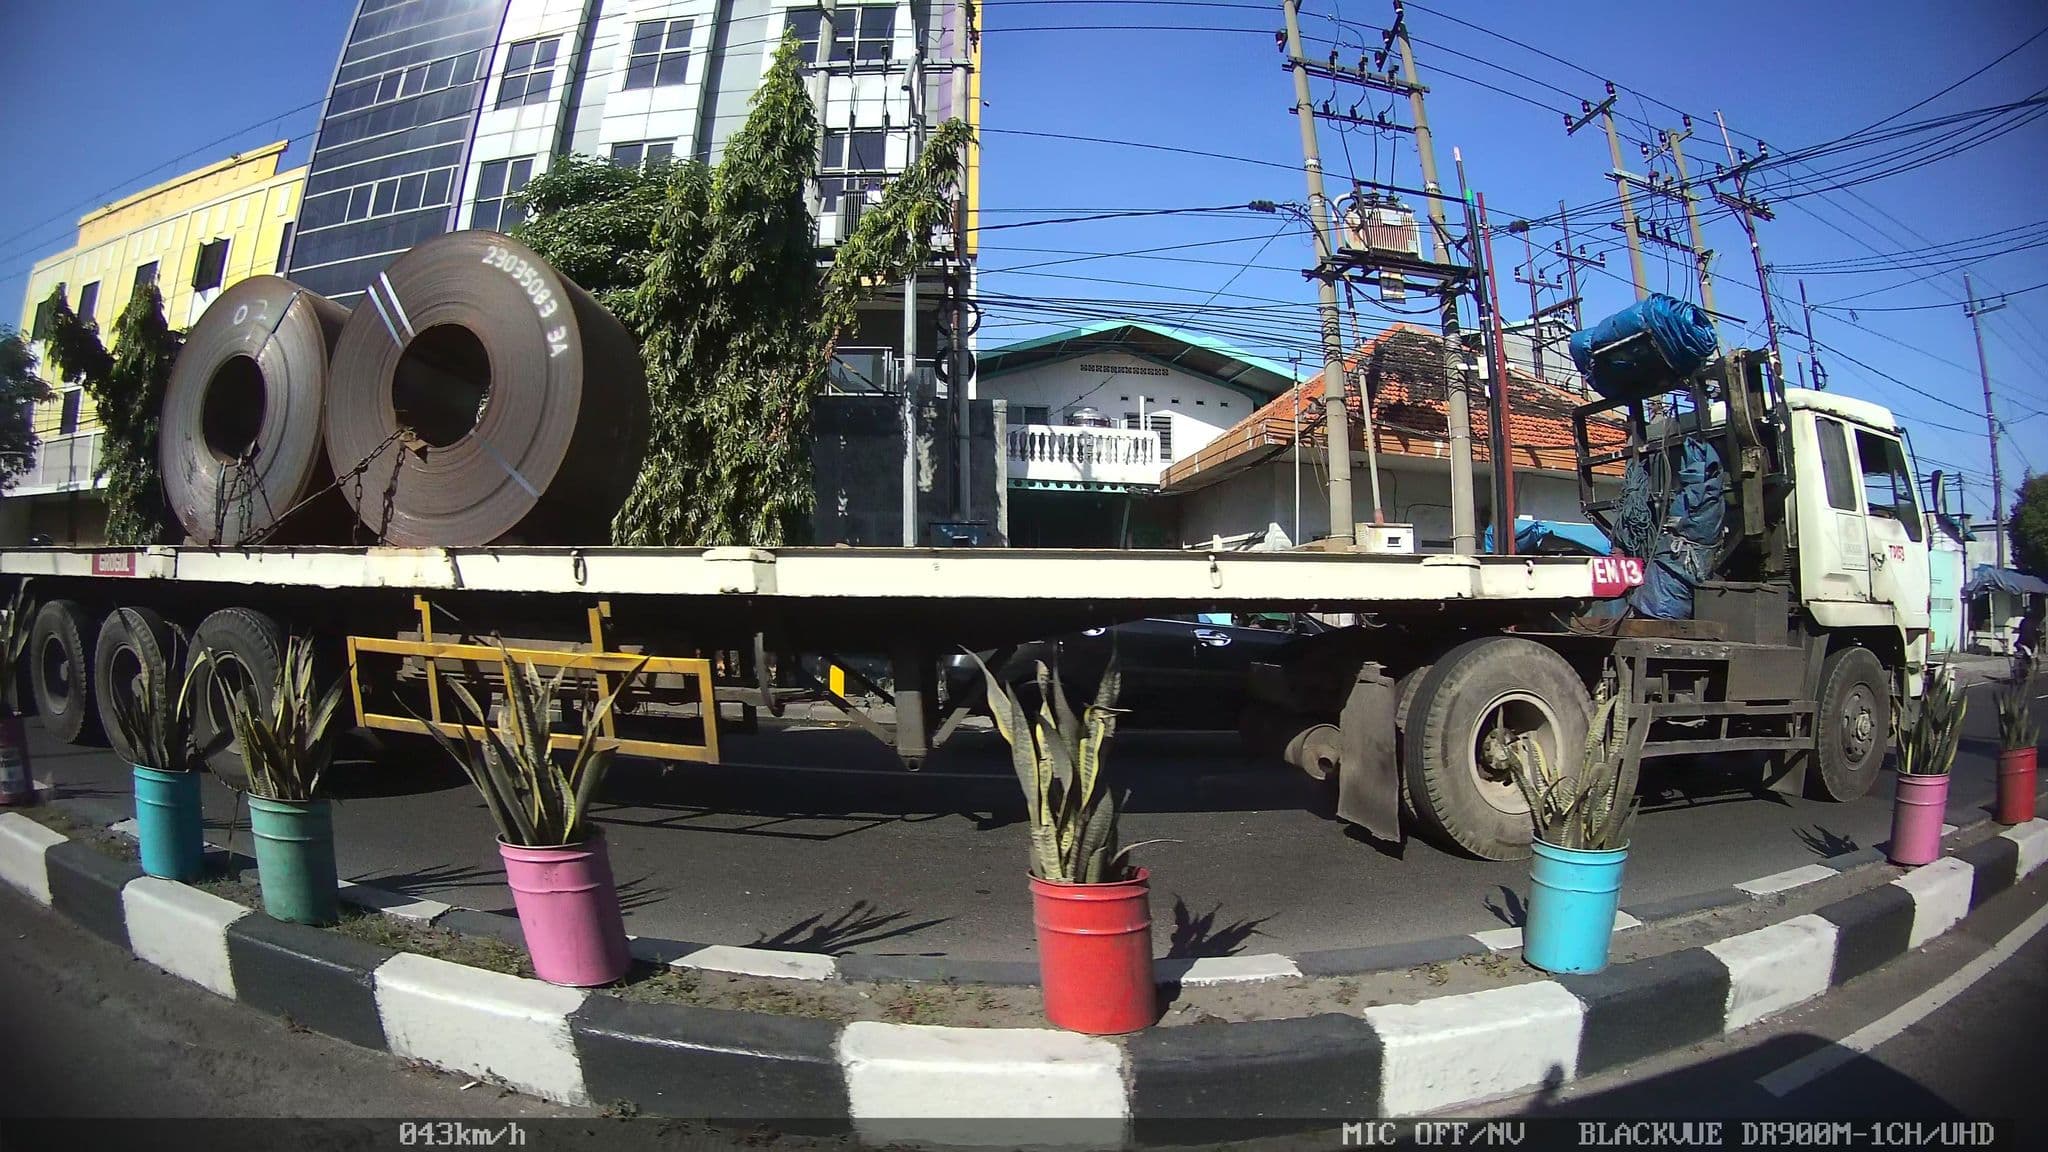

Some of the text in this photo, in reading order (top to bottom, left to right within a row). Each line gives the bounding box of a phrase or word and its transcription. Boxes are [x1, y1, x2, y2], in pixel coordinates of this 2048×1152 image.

[481, 246, 558, 318] 23035083
[1593, 558, 1643, 585] EM 13
